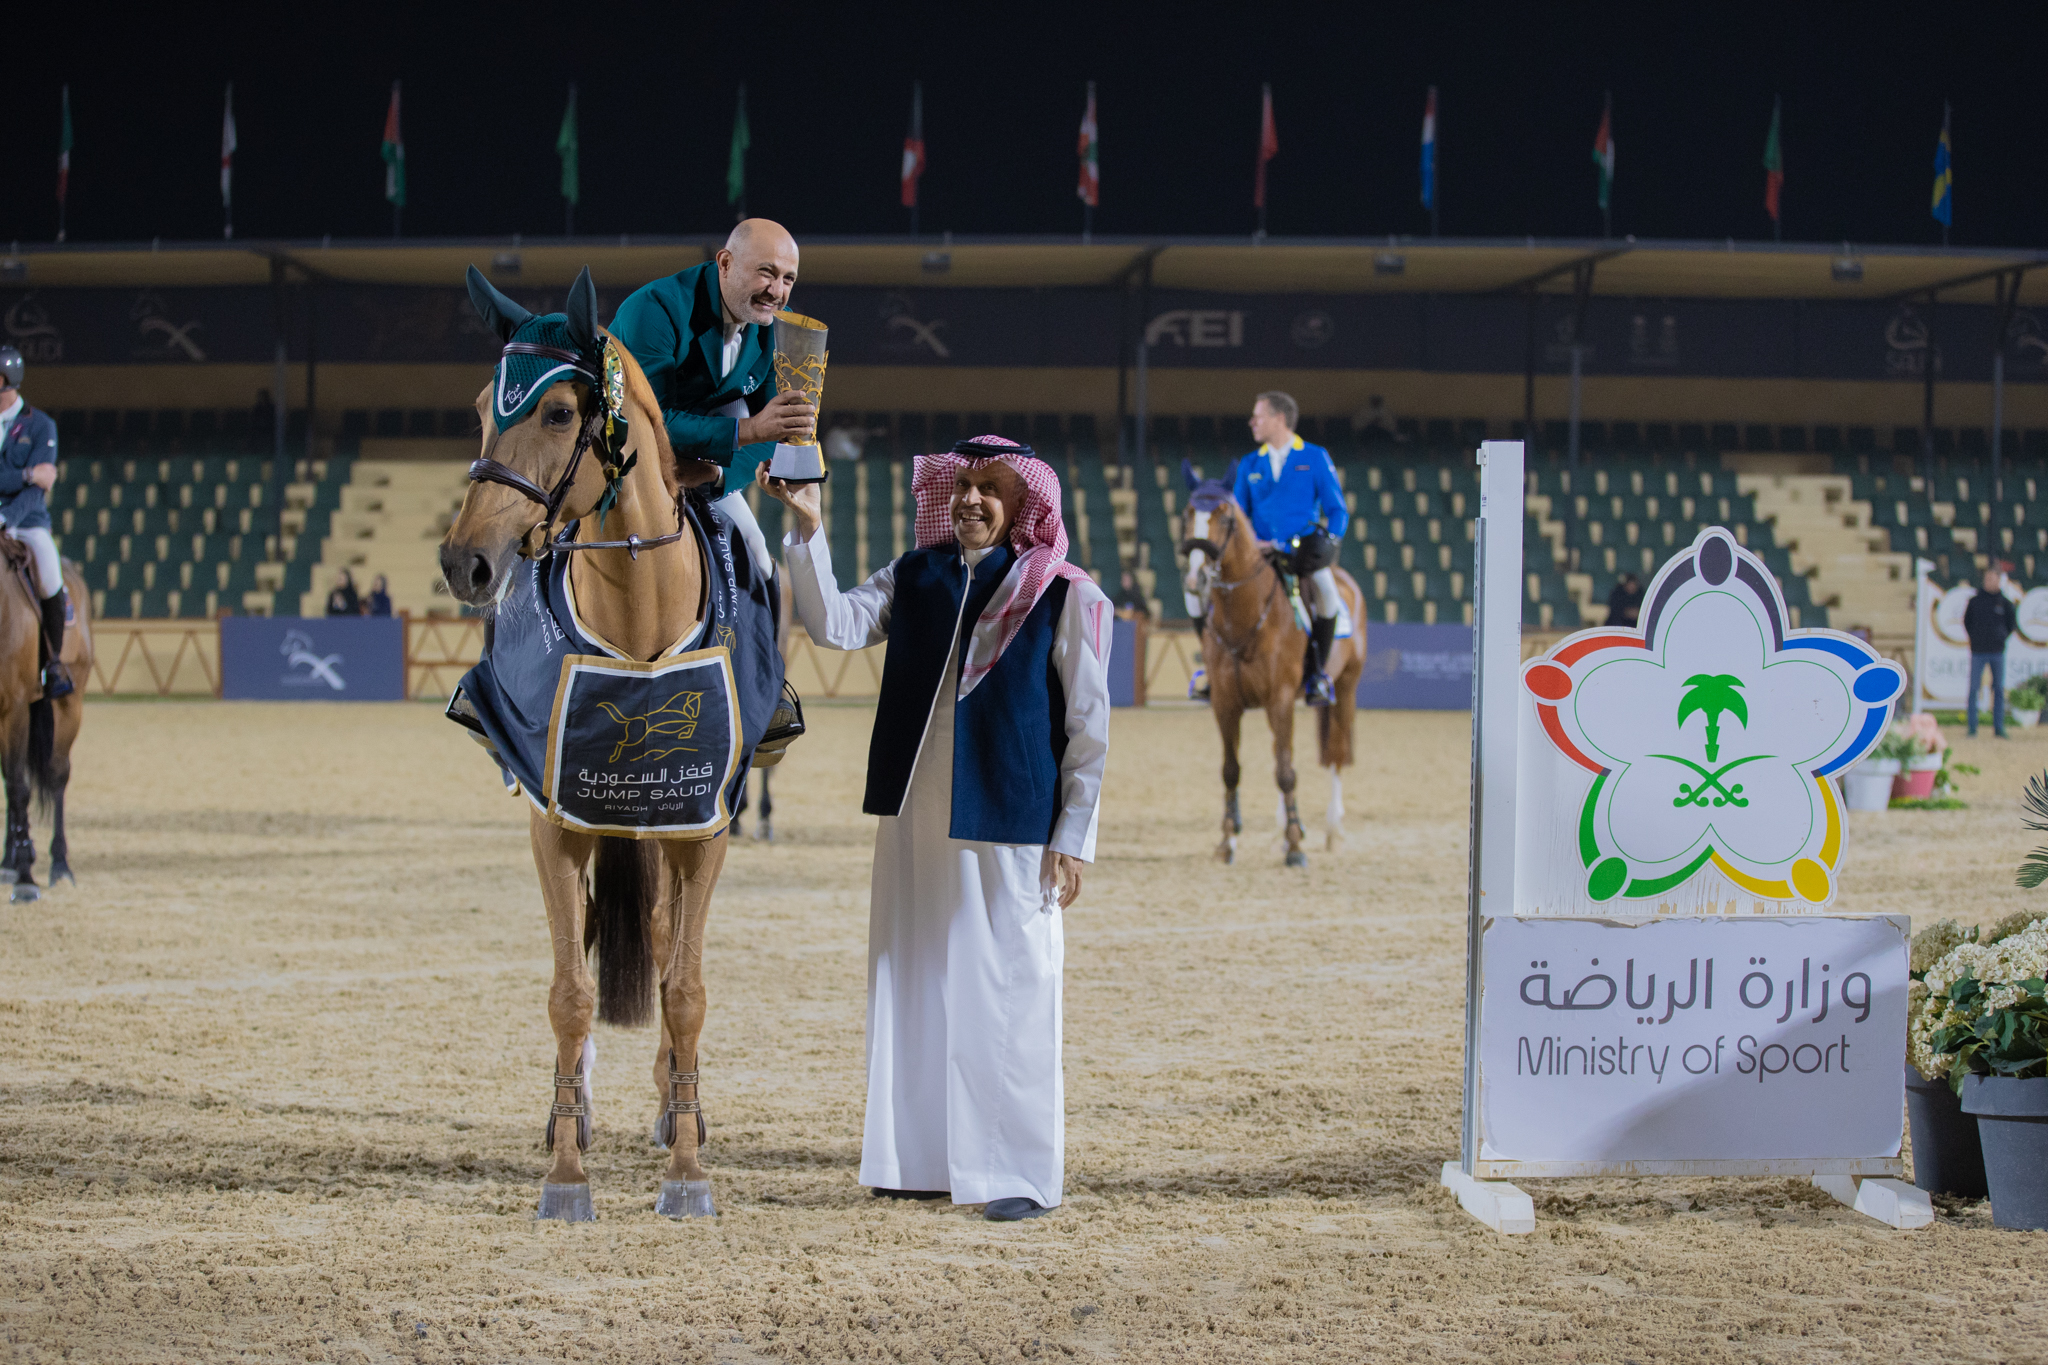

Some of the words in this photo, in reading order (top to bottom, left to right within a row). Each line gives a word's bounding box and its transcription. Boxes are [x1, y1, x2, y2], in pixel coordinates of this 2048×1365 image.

[1145, 310, 1244, 347] FEI
[717, 529, 734, 574] SAUDI
[576, 787, 641, 800] JUMP
[650, 782, 711, 800] SAUDI
[578, 768, 667, 786] السعودية
[670, 761, 713, 784] قفز
[604, 804, 648, 812] RIYADH
[1519, 957, 1714, 1026] الرياضة
[1739, 956, 1872, 1024] وزارة
[1517, 1035, 1670, 1084] Ministry
[1682, 1035, 1725, 1075] of
[1736, 1034, 1850, 1083] Sport
